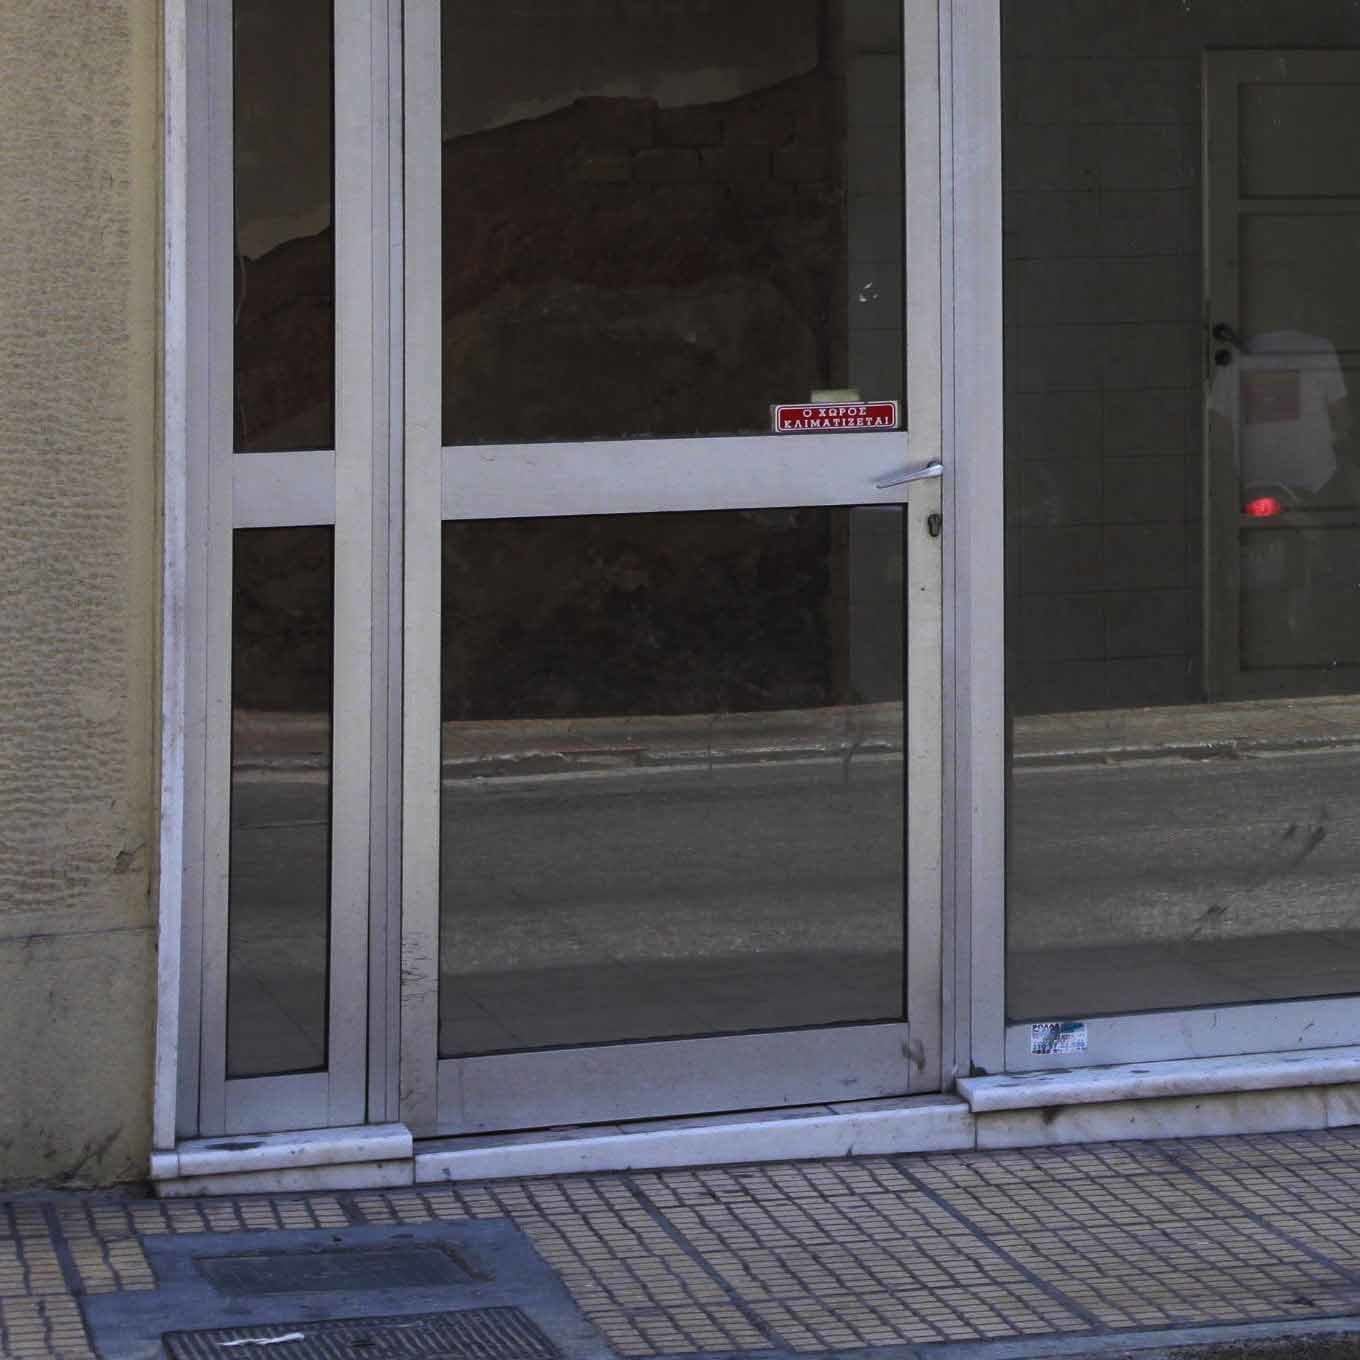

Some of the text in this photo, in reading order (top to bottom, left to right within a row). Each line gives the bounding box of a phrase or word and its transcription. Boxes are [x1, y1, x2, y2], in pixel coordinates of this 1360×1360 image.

[803, 407, 867, 418] Ο ΧΩΡΟΣ
[784, 416, 890, 429] ΚΛΙΜΑΤΙΖΕΤΑΙ
